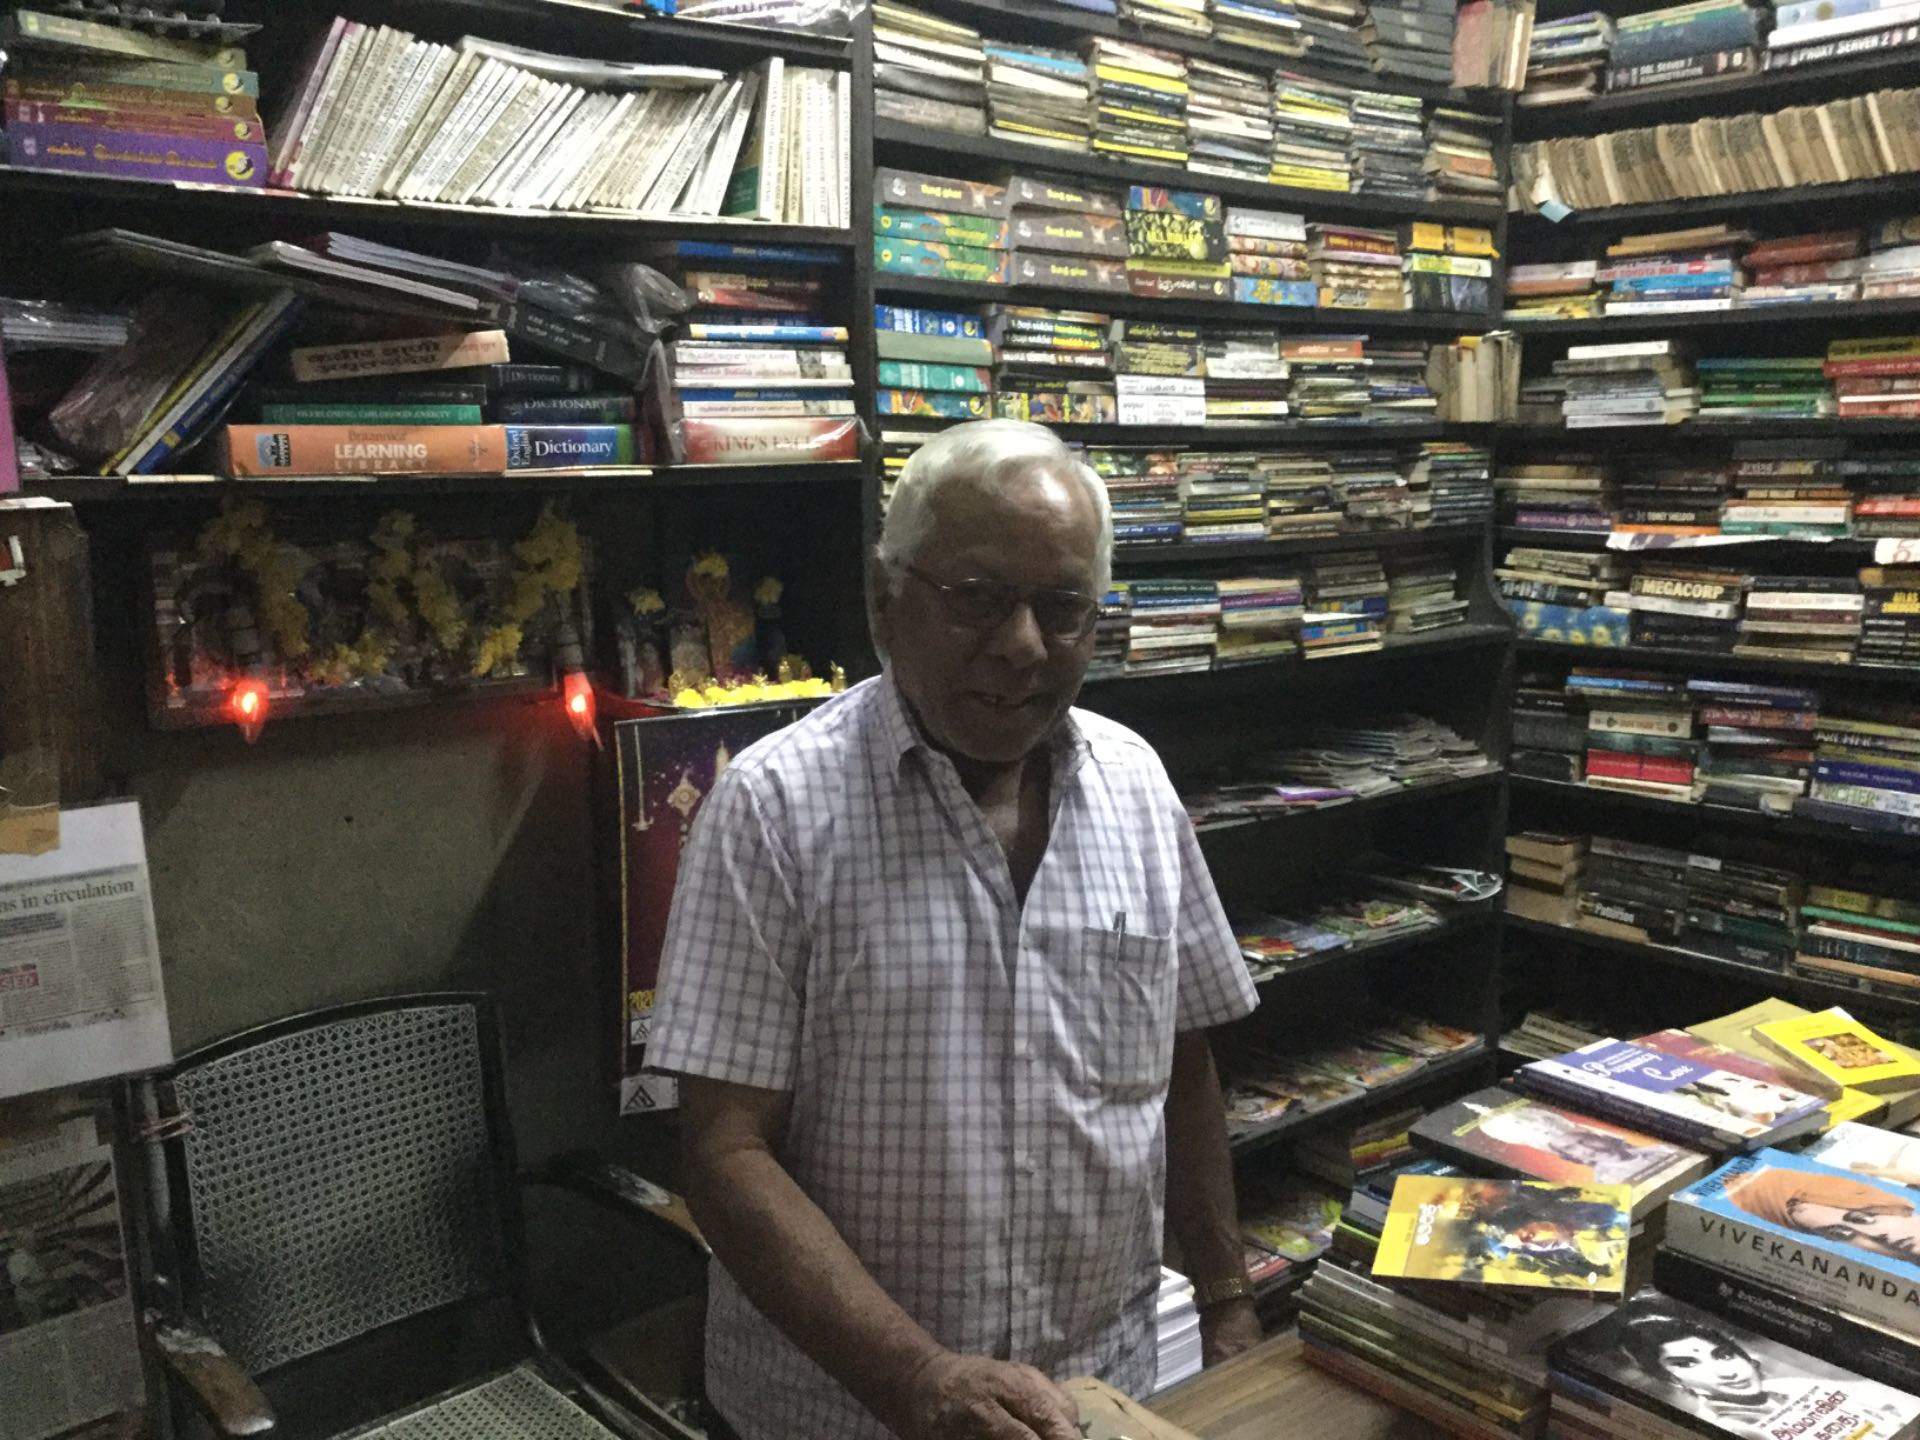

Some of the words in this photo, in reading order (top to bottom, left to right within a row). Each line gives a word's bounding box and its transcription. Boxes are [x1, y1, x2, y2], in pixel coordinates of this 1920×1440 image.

[335, 443, 428, 459] LEARNING
[508, 429, 521, 466] Oxford
[520, 430, 532, 465] English
[534, 439, 613, 457] Dictionary
[1641, 579, 1725, 600] MEGACORP
[22, 894, 39, 909] in
[44, 880, 134, 906] circulation
[1699, 1216, 1920, 1307] VIVEKANANDA
